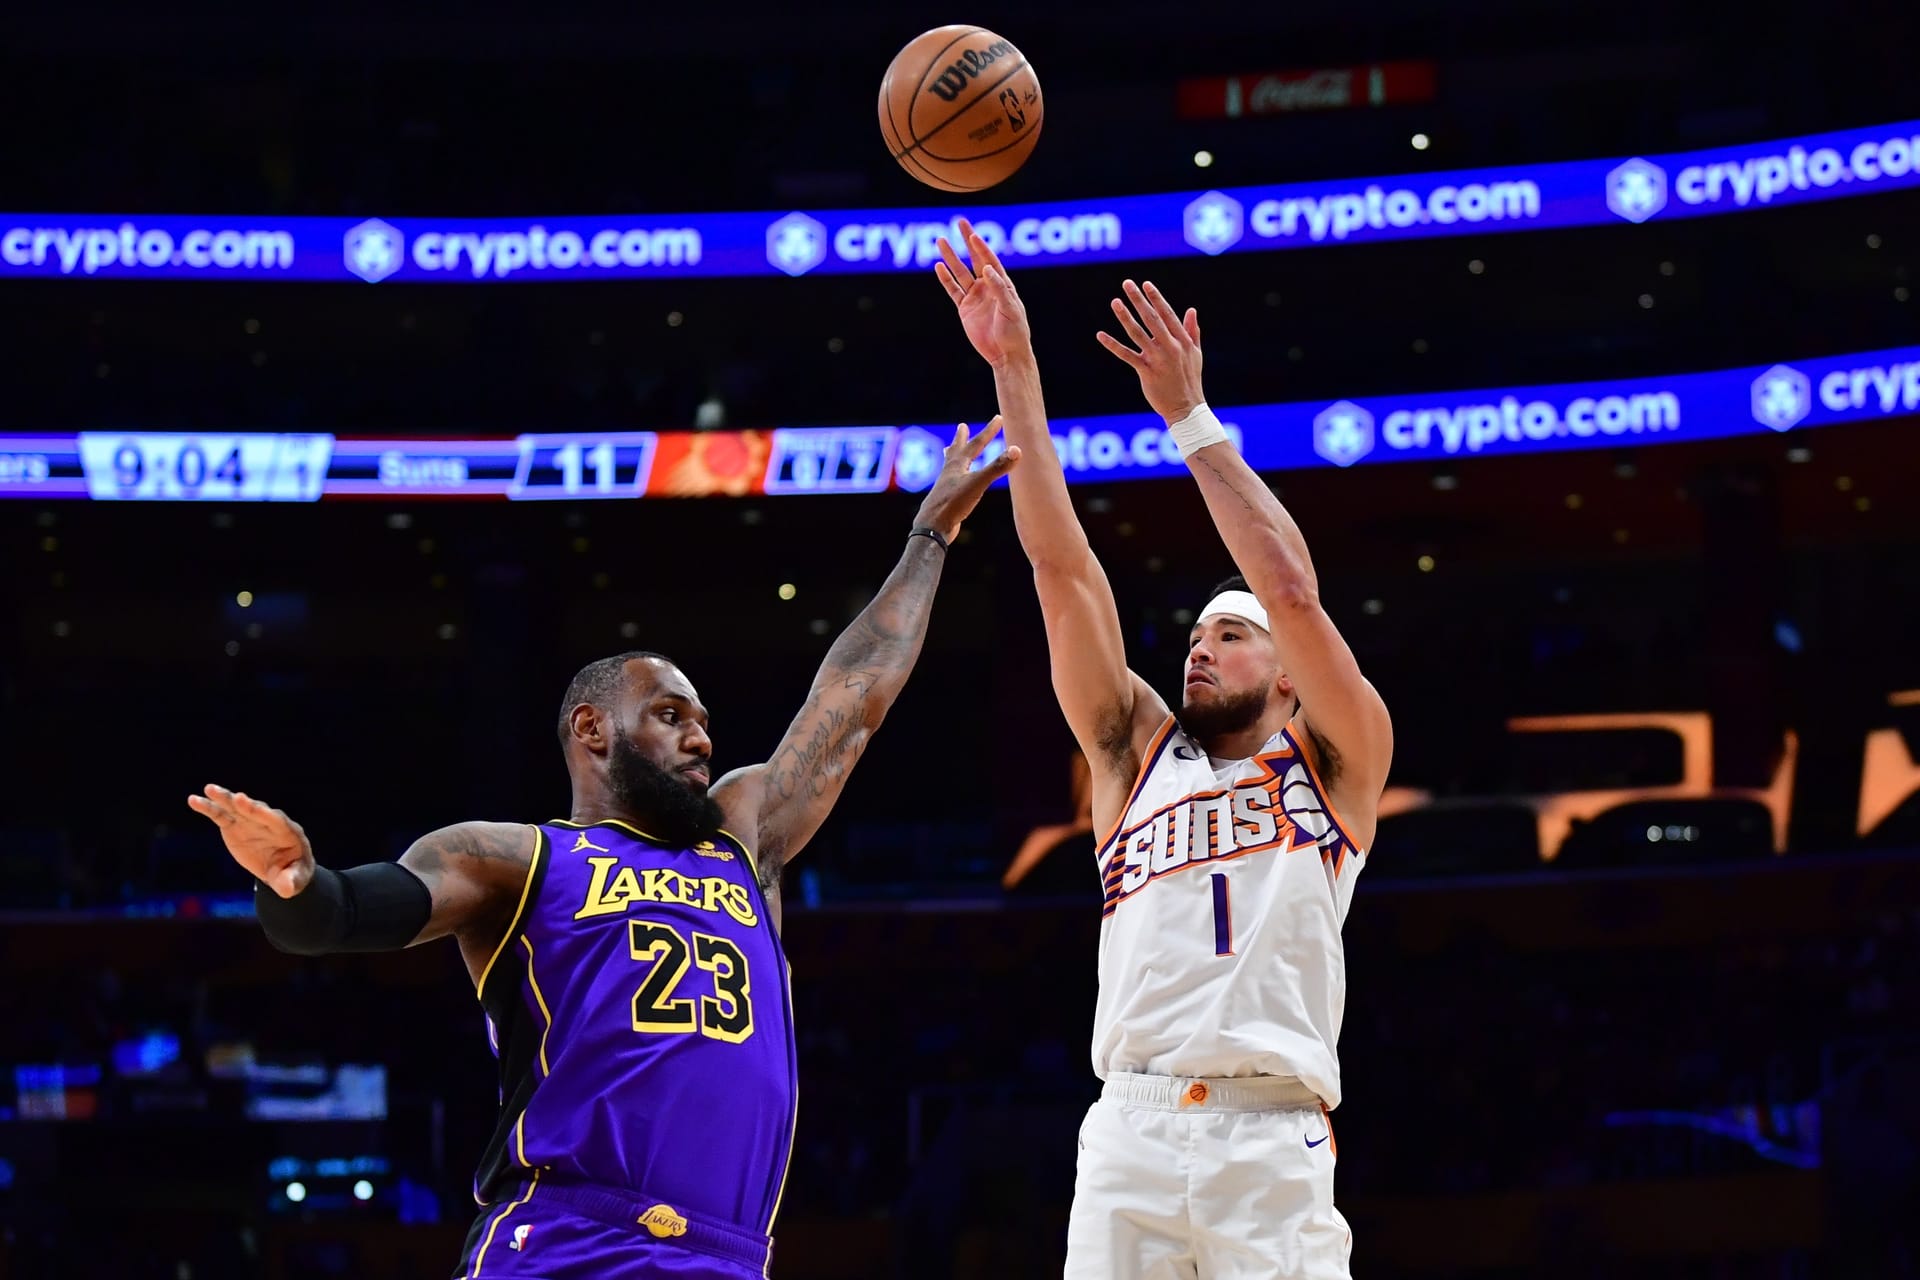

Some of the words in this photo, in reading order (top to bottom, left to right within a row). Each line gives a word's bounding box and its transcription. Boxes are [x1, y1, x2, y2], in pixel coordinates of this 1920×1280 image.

[928, 40, 1017, 101] Wilson
[1251, 181, 1540, 240] crypto.com
[2, 223, 294, 273] crypto.com
[413, 226, 701, 277] crypto.com
[1383, 392, 1680, 452] crypto.com
[113, 444, 243, 487] 9:04
[378, 451, 469, 486] Suns
[551, 442, 615, 494] 11
[573, 856, 758, 927] LAKERS
[1209, 872, 1235, 957] 1
[628, 919, 754, 1044] 23
[643, 1209, 683, 1233] LAKERS
